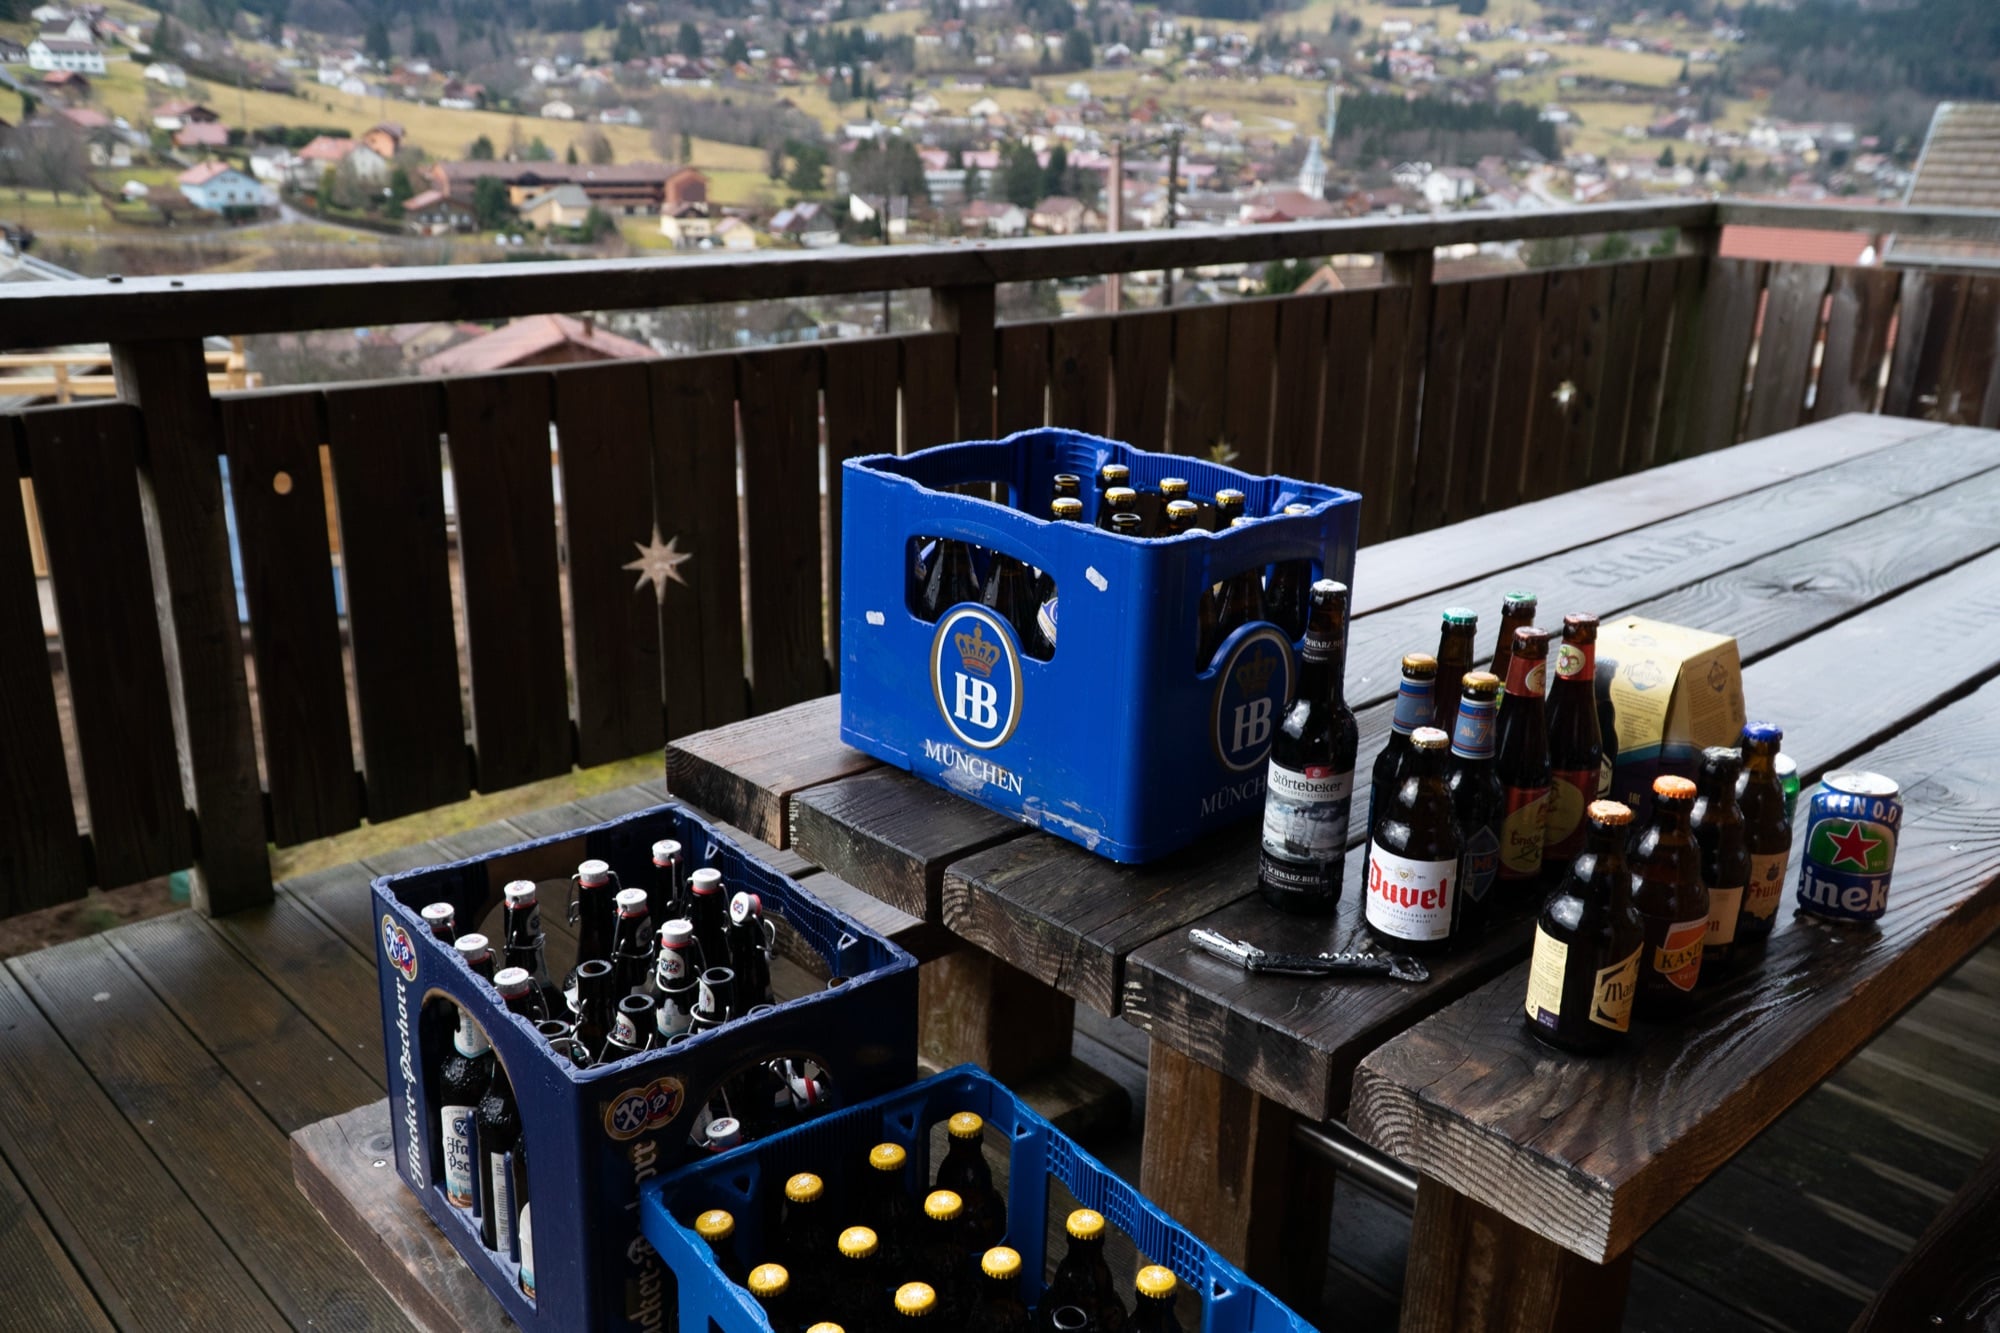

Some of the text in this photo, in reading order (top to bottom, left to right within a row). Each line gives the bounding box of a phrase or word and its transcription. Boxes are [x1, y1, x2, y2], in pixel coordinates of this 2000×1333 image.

[954, 671, 998, 730] HB
[1231, 696, 1272, 752] HB
[924, 738, 1023, 796] MÜNCHEN
[1273, 770, 1344, 794] Störtebeker
[1200, 773, 1268, 818] MÜNCH
[1370, 857, 1447, 910] Duvel
[395, 976, 425, 1190] Hacker-Pschorr
